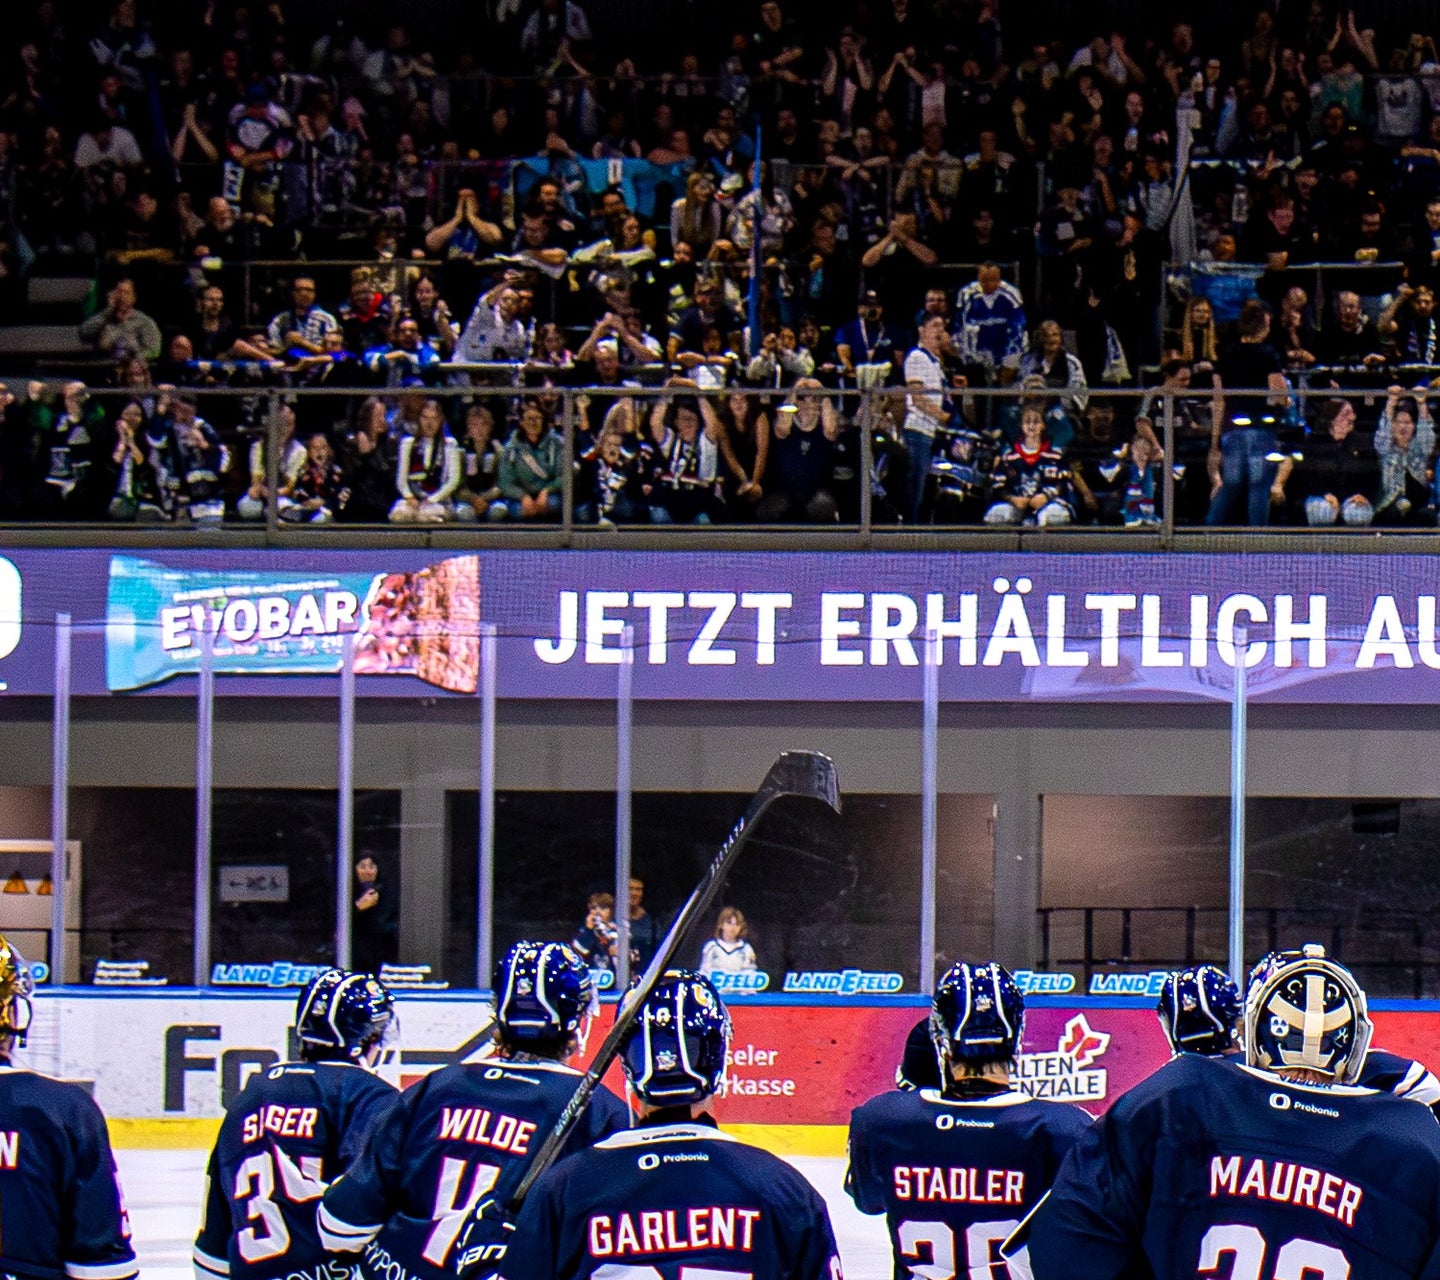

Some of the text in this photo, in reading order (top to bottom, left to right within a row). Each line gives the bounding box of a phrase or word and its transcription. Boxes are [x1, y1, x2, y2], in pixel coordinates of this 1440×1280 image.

[532, 589, 793, 667] JETZT
[819, 576, 1328, 669] ERHÄLTLICH
[211, 961, 325, 987] LANDEFE
[709, 970, 771, 992] EFELD
[782, 969, 904, 995] LANDEFELD
[1013, 970, 1076, 995] EFELD
[1089, 971, 1170, 996] LANDE
[725, 1045, 779, 1068] seler
[1007, 1054, 1077, 1077] ALTEN
[721, 1074, 796, 1098] rkasse
[1010, 1074, 1103, 1099] ENZIALE
[440, 1107, 538, 1156] WILDE
[893, 1166, 1025, 1204] STADLER
[1210, 1155, 1364, 1226] MAURER
[589, 1206, 760, 1258] GARLENT
